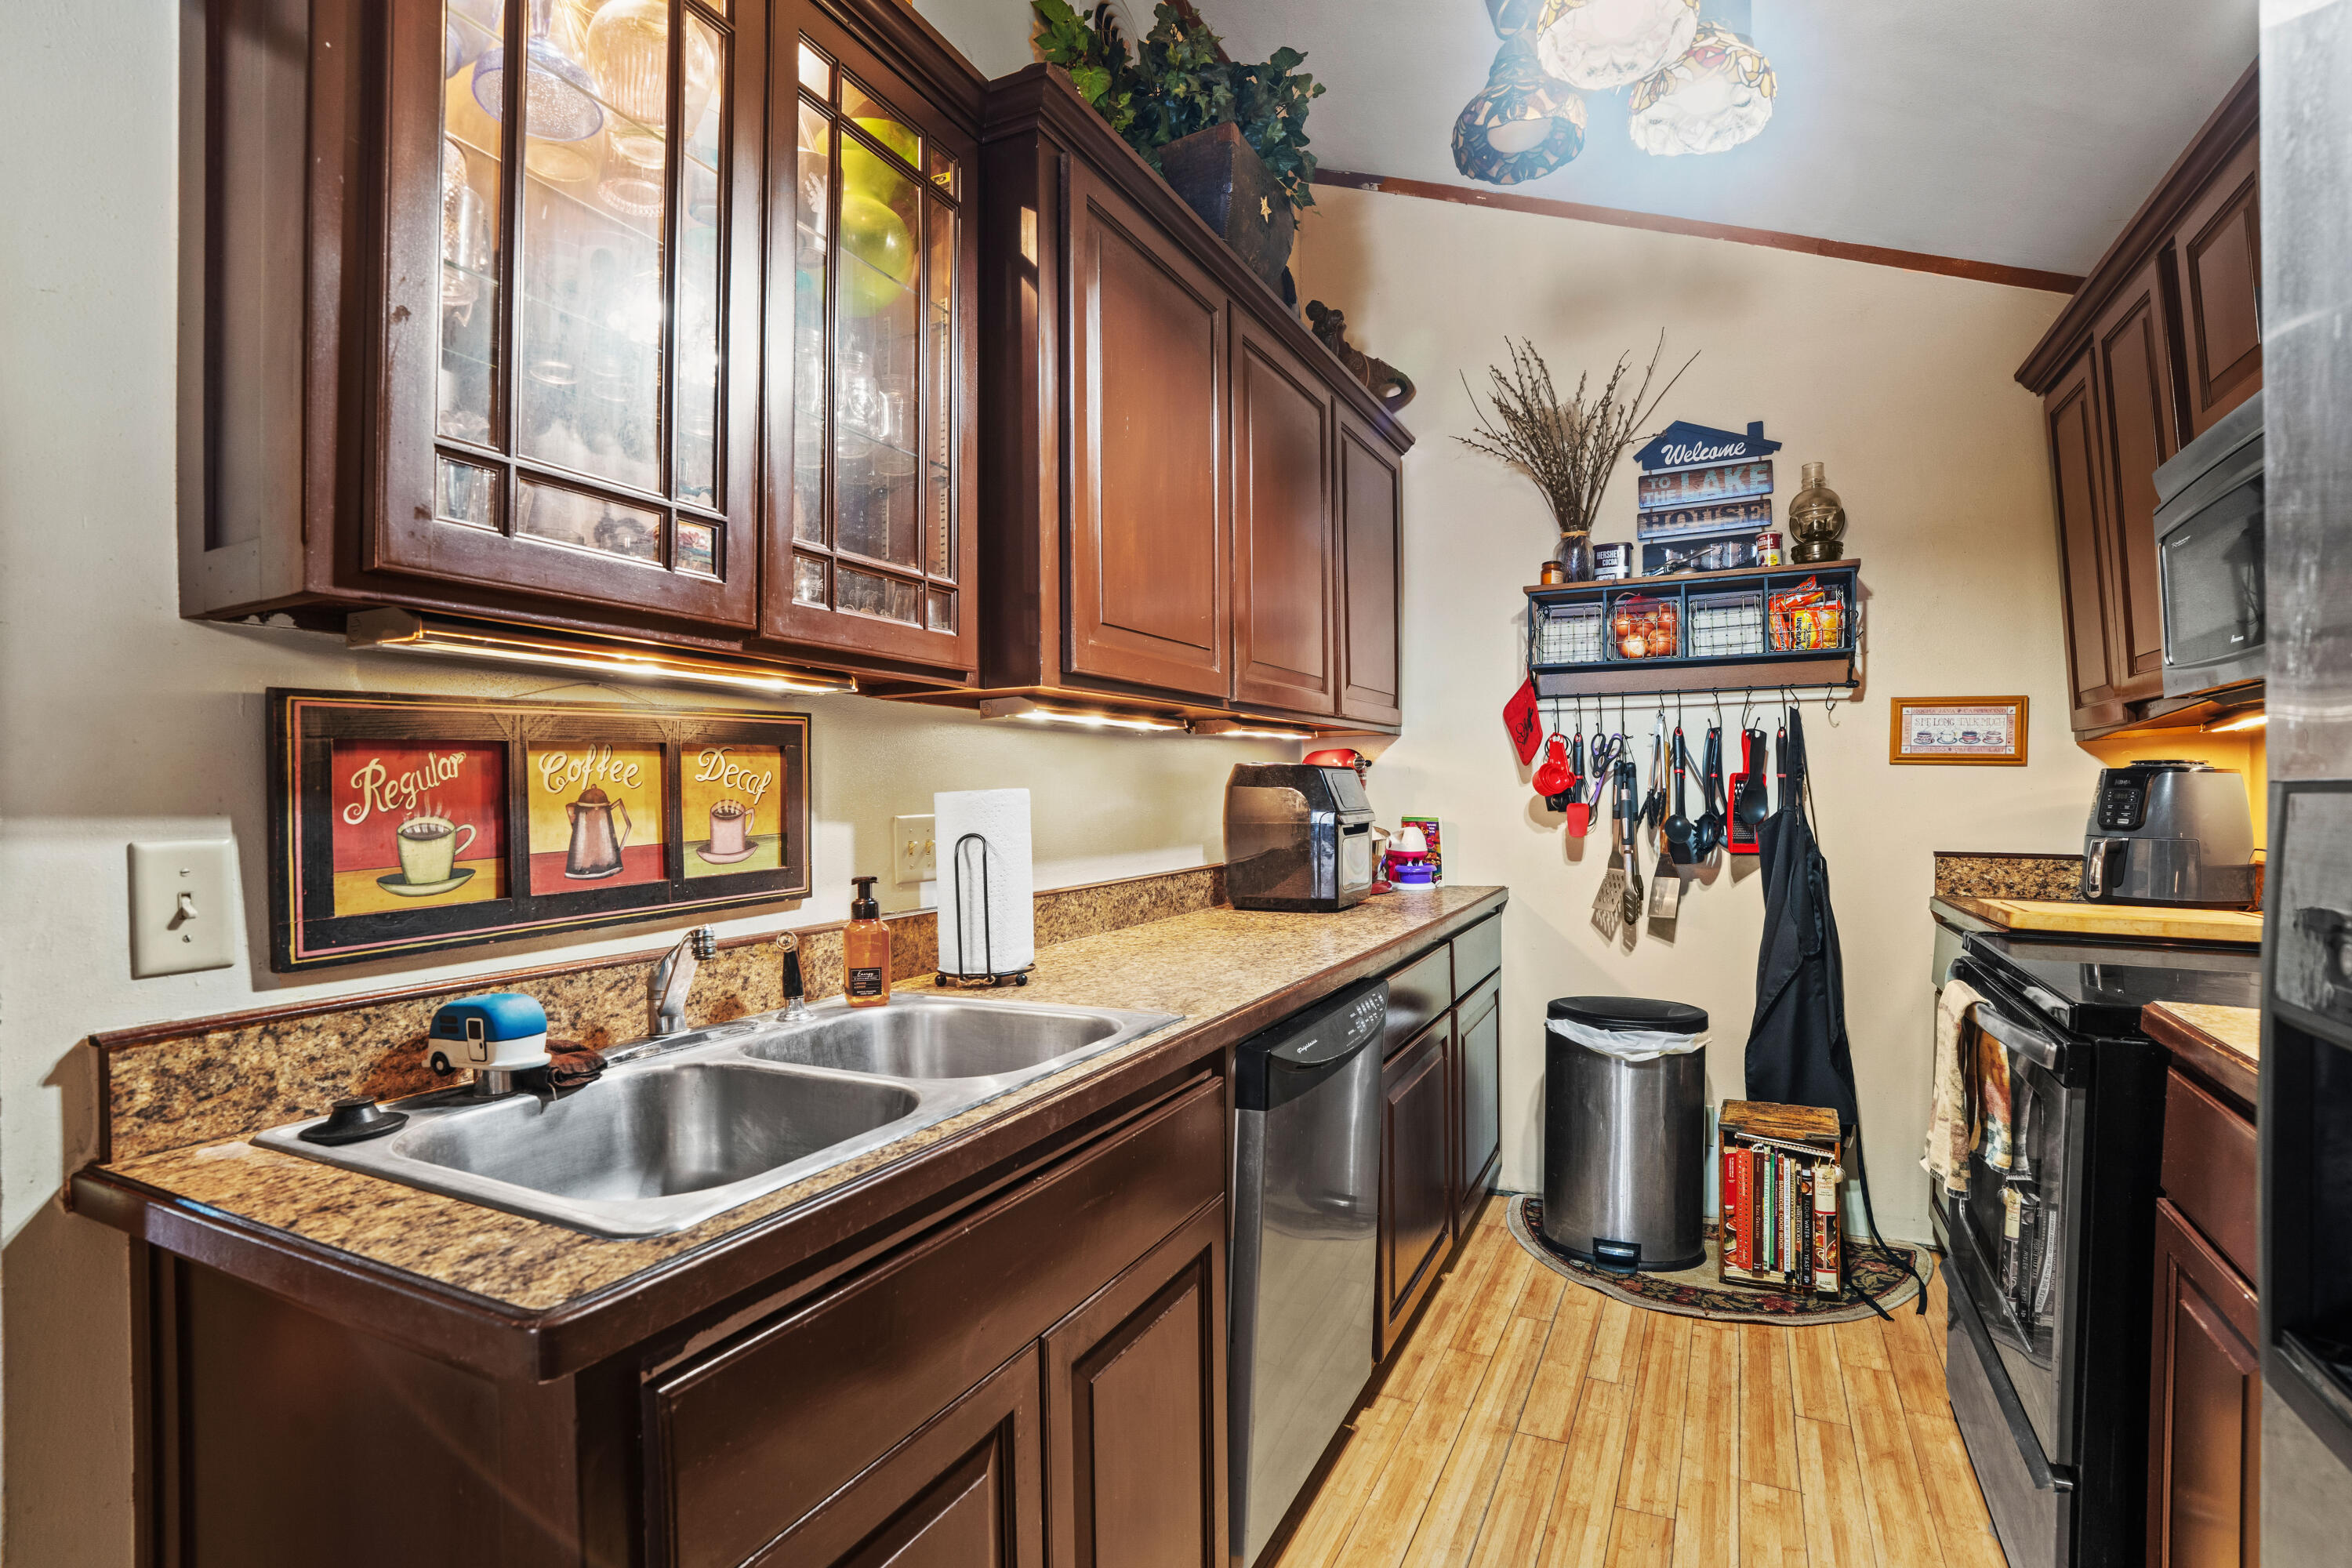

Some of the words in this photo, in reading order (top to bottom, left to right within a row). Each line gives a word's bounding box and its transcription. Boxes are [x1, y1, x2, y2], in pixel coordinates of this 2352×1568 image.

[1661, 441, 1746, 465] Welcome
[1648, 476, 1671, 490] TO
[1680, 464, 1769, 503] LAKE
[1643, 489, 1677, 505] THE
[1644, 503, 1765, 528] HOUSE
[1602, 557, 1617, 566] COCOA
[1933, 717, 1955, 727] LONG
[1958, 717, 1979, 727] TALK
[1980, 717, 2005, 727] MUCH
[539, 742, 644, 794] Coffee
[695, 746, 774, 806] Decaf
[343, 751, 468, 825] Regular
